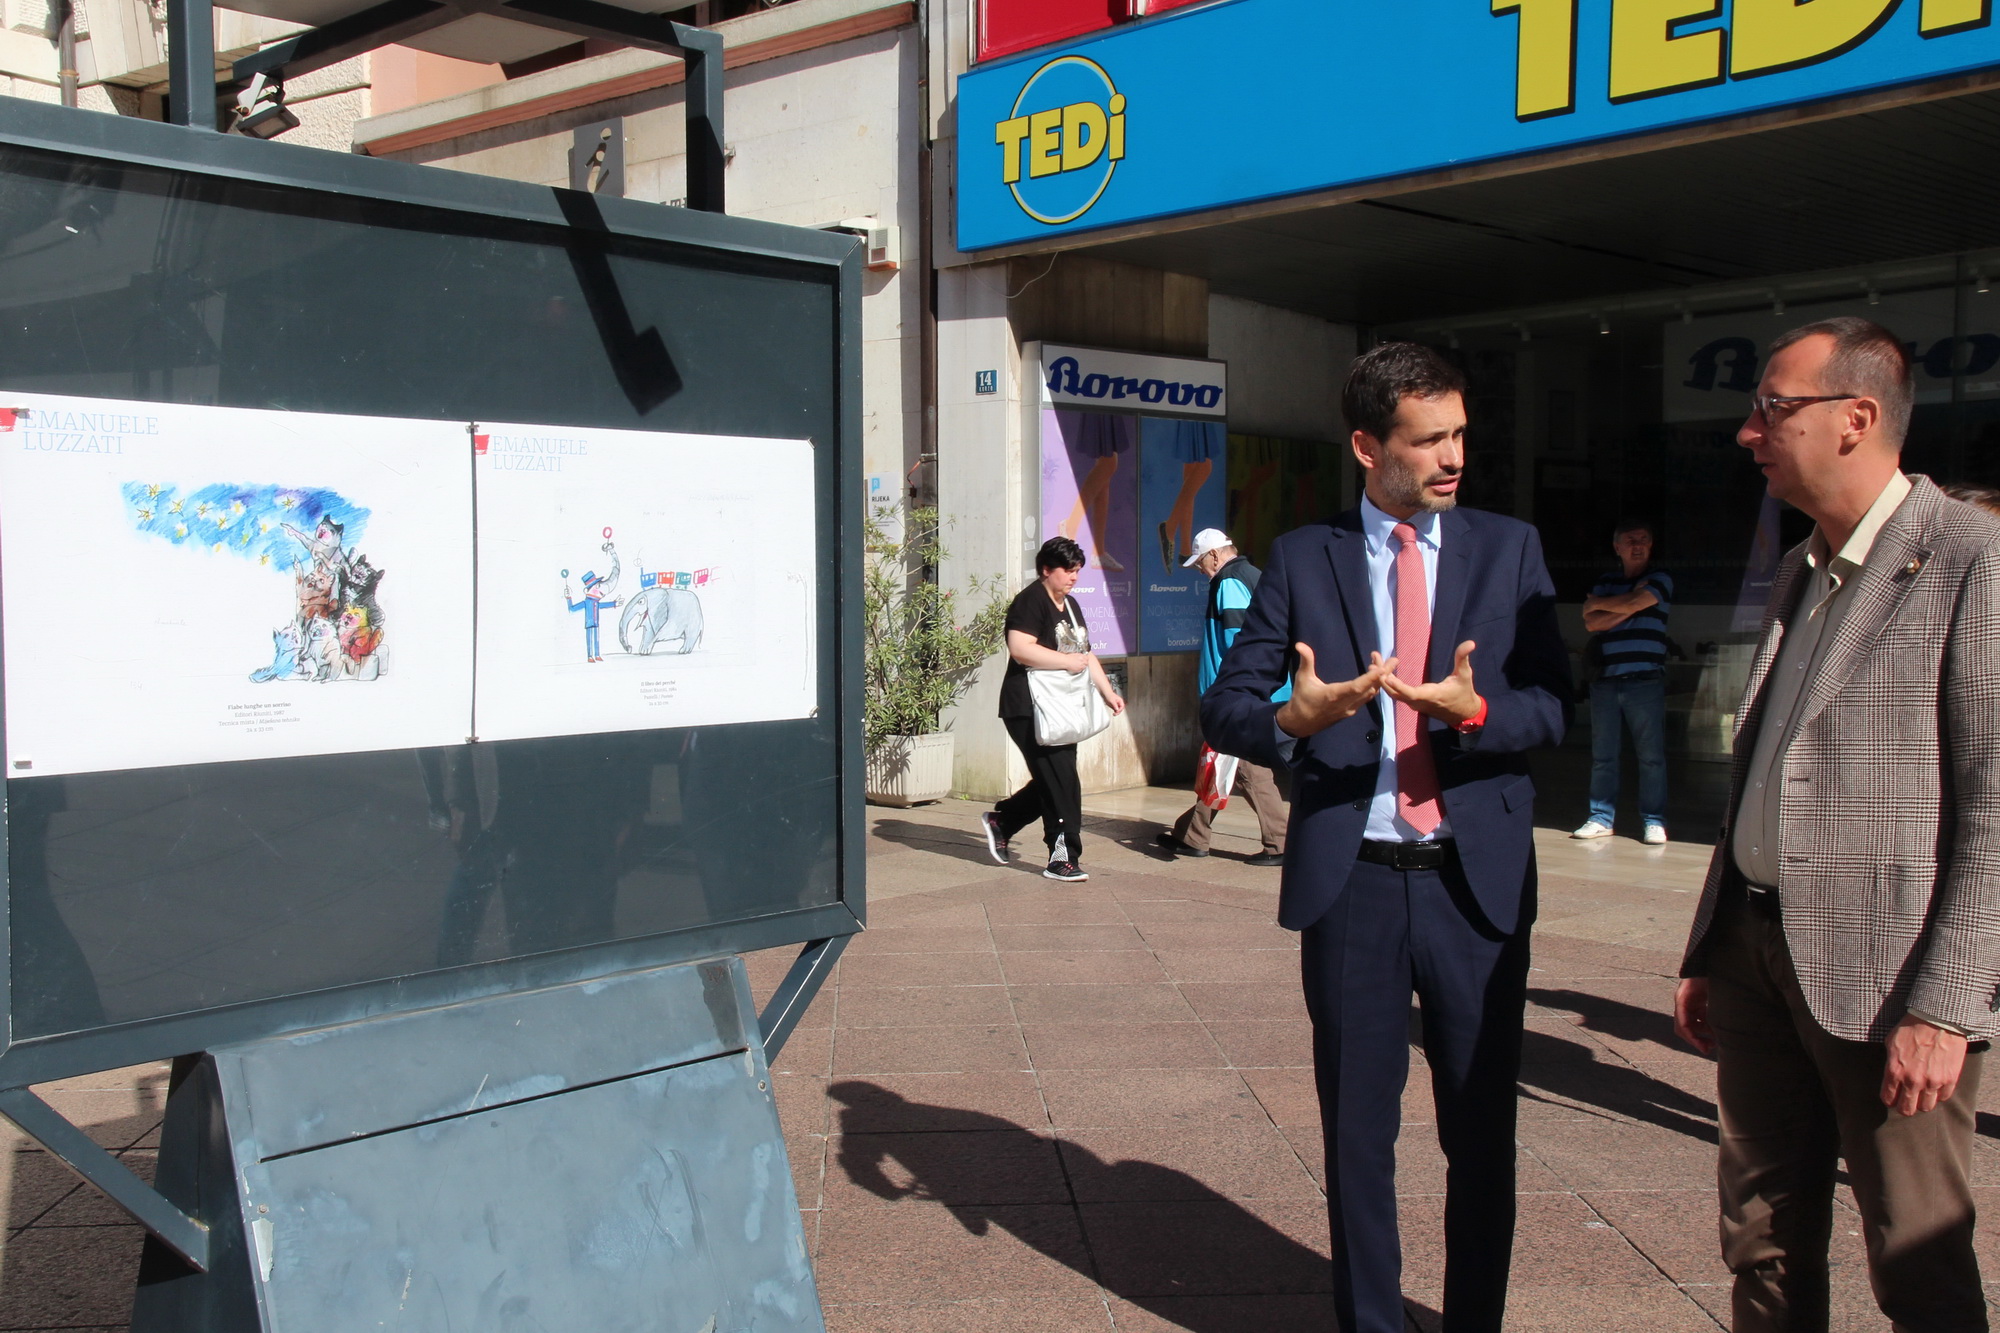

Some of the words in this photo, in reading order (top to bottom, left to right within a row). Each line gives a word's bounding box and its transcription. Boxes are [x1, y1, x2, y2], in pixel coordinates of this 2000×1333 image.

[1491, 0, 1991, 123] TE
[995, 93, 1127, 185] TEDi
[980, 371, 992, 386] 14
[1047, 356, 1223, 408] Borovo
[23, 409, 159, 435] EMANUELE
[23, 431, 123, 455] LUZZATI
[492, 435, 588, 456] EMANUELE
[493, 454, 562, 472] LUZZATI
[1086, 621, 1110, 633] ROVA
[1167, 636, 1199, 646] borovo.hr
